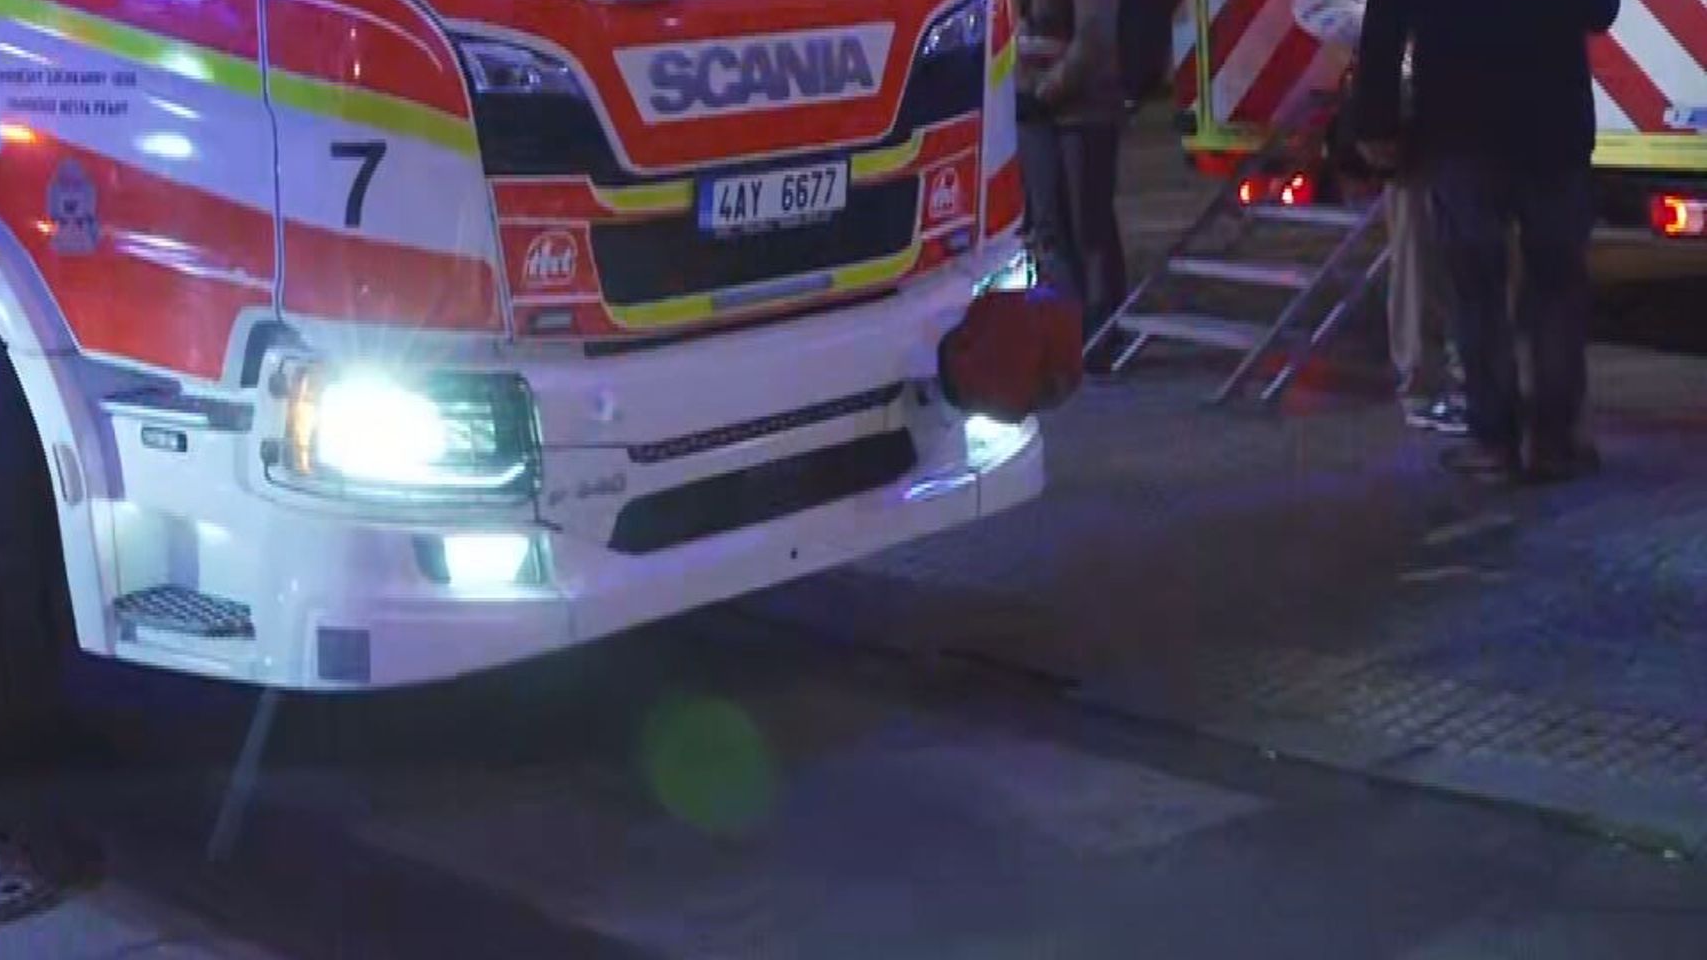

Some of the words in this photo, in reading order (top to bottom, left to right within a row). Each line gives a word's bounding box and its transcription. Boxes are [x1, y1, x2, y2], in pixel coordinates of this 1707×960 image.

[649, 36, 875, 115] SCANIA
[330, 141, 387, 228] 7
[719, 180, 763, 221] 4AY
[781, 167, 837, 211] 6677
